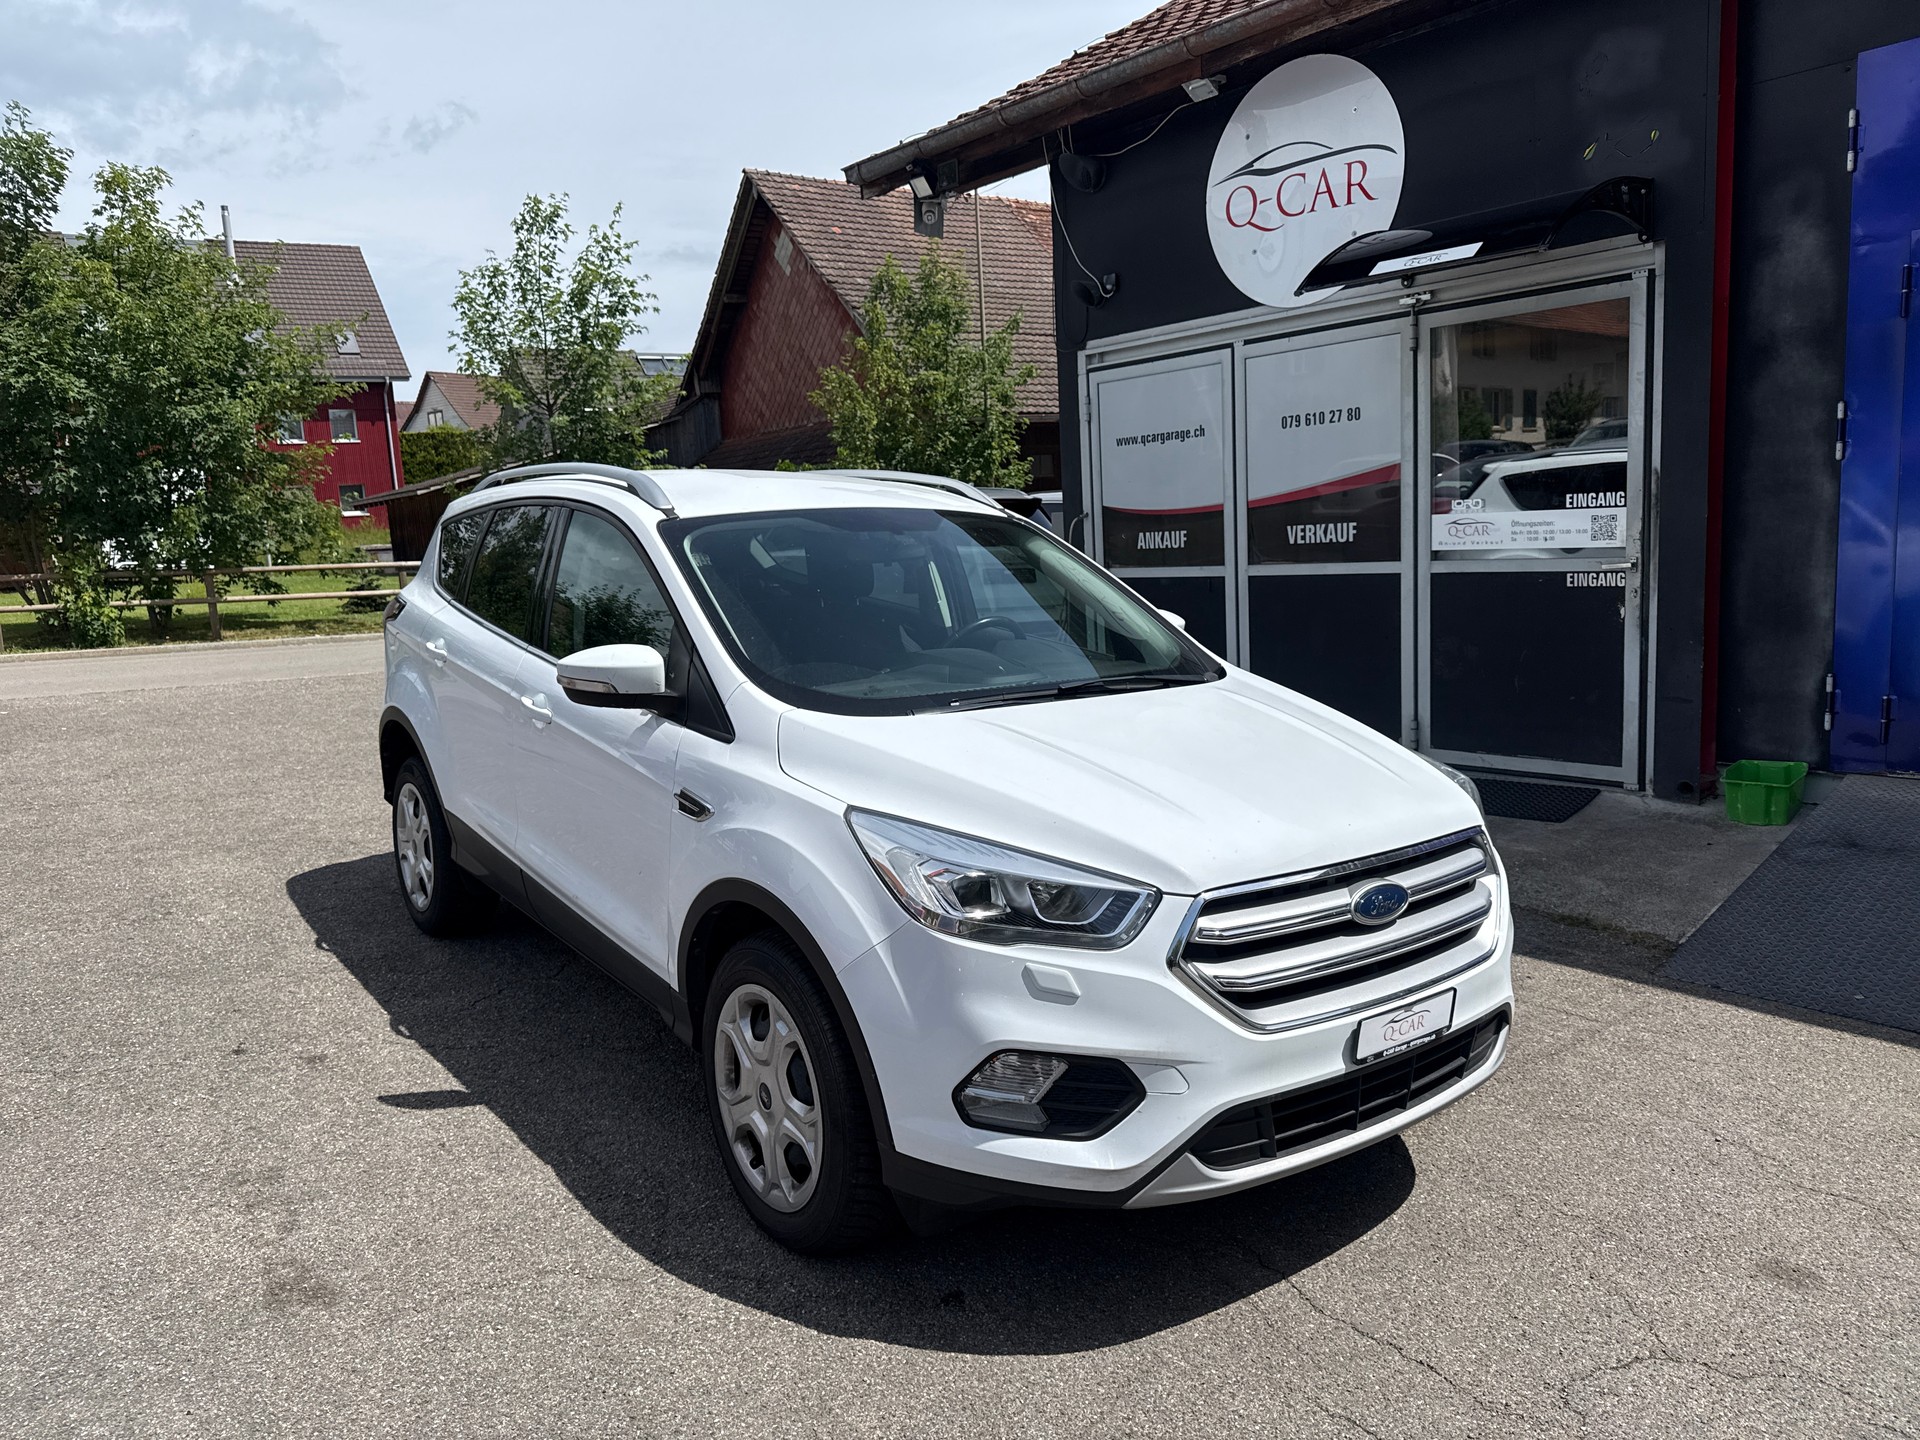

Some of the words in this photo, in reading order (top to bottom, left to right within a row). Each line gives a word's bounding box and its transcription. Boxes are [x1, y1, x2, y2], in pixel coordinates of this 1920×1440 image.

[1225, 160, 1379, 232] Q-CAR
[1403, 254, 1442, 267] Q-CAR
[1281, 414, 1301, 430] 079
[1305, 411, 1325, 427] 610
[1329, 409, 1342, 424] 27
[1347, 406, 1361, 422] 80
[1116, 424, 1206, 447] www.qcargarage.ch
[1565, 491, 1625, 508] EINGANG
[1286, 521, 1358, 545] VERKAUF
[1447, 524, 1491, 539] Q-CAR
[1510, 519, 1556, 528] Öffnungszeiten:
[1137, 530, 1187, 550] ANKAUF
[1566, 572, 1626, 587] EINGANG
[1383, 1015, 1425, 1042] Q-CAR
